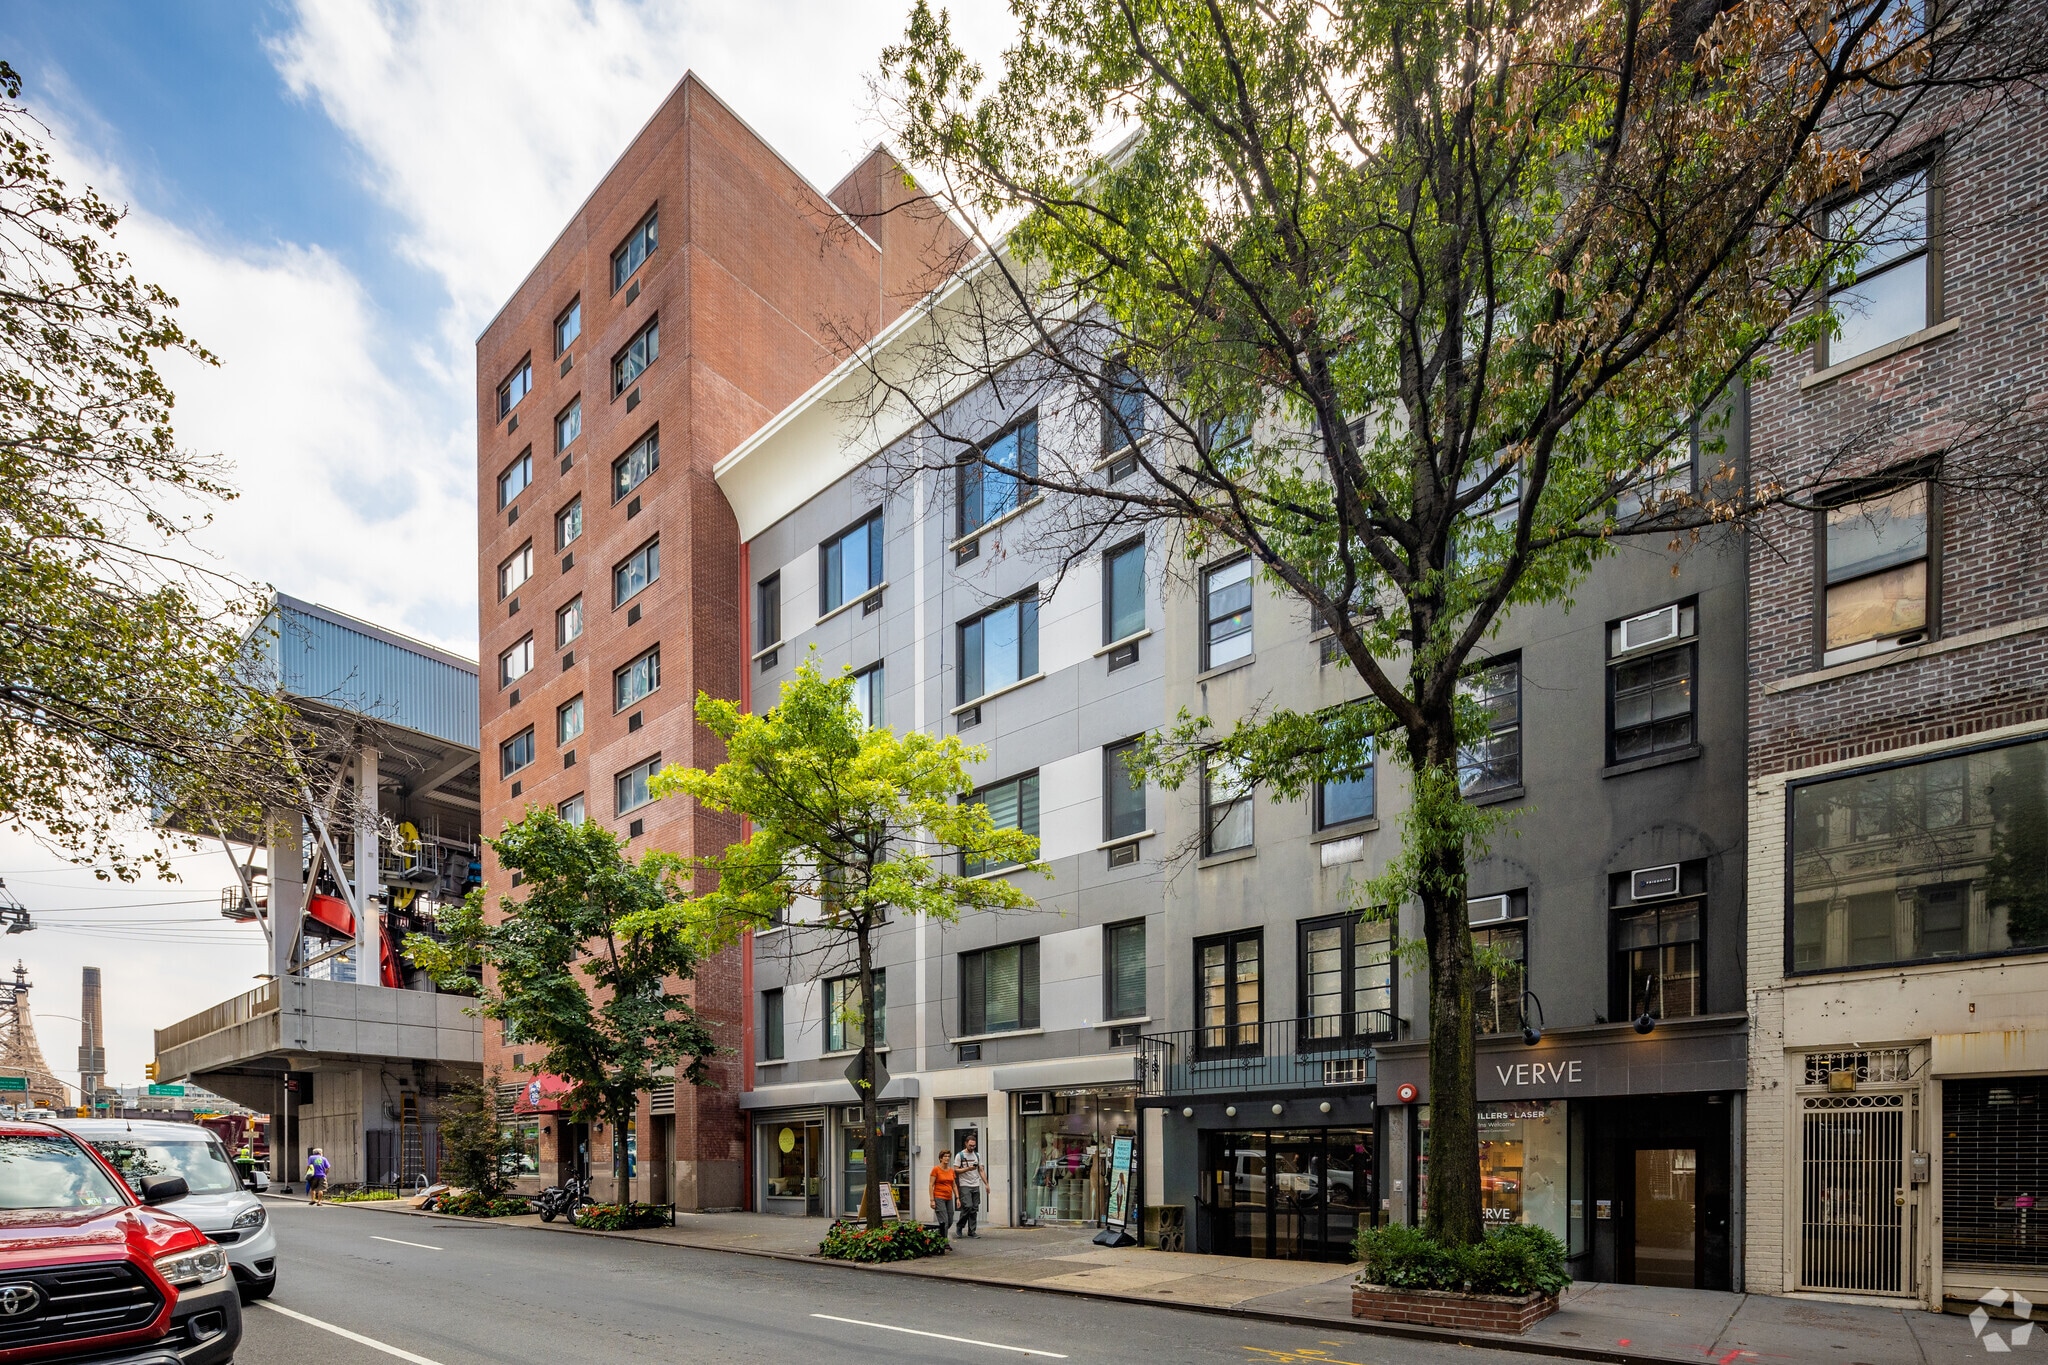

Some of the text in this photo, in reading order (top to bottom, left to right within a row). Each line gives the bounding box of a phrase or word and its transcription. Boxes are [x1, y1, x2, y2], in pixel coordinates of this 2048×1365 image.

[1496, 1060, 1582, 1086] VERVE
[1477, 1111, 1545, 1120] ILLERS LASER
[1040, 1207, 1058, 1216] SALE
[1483, 1208, 1510, 1219] RVE
